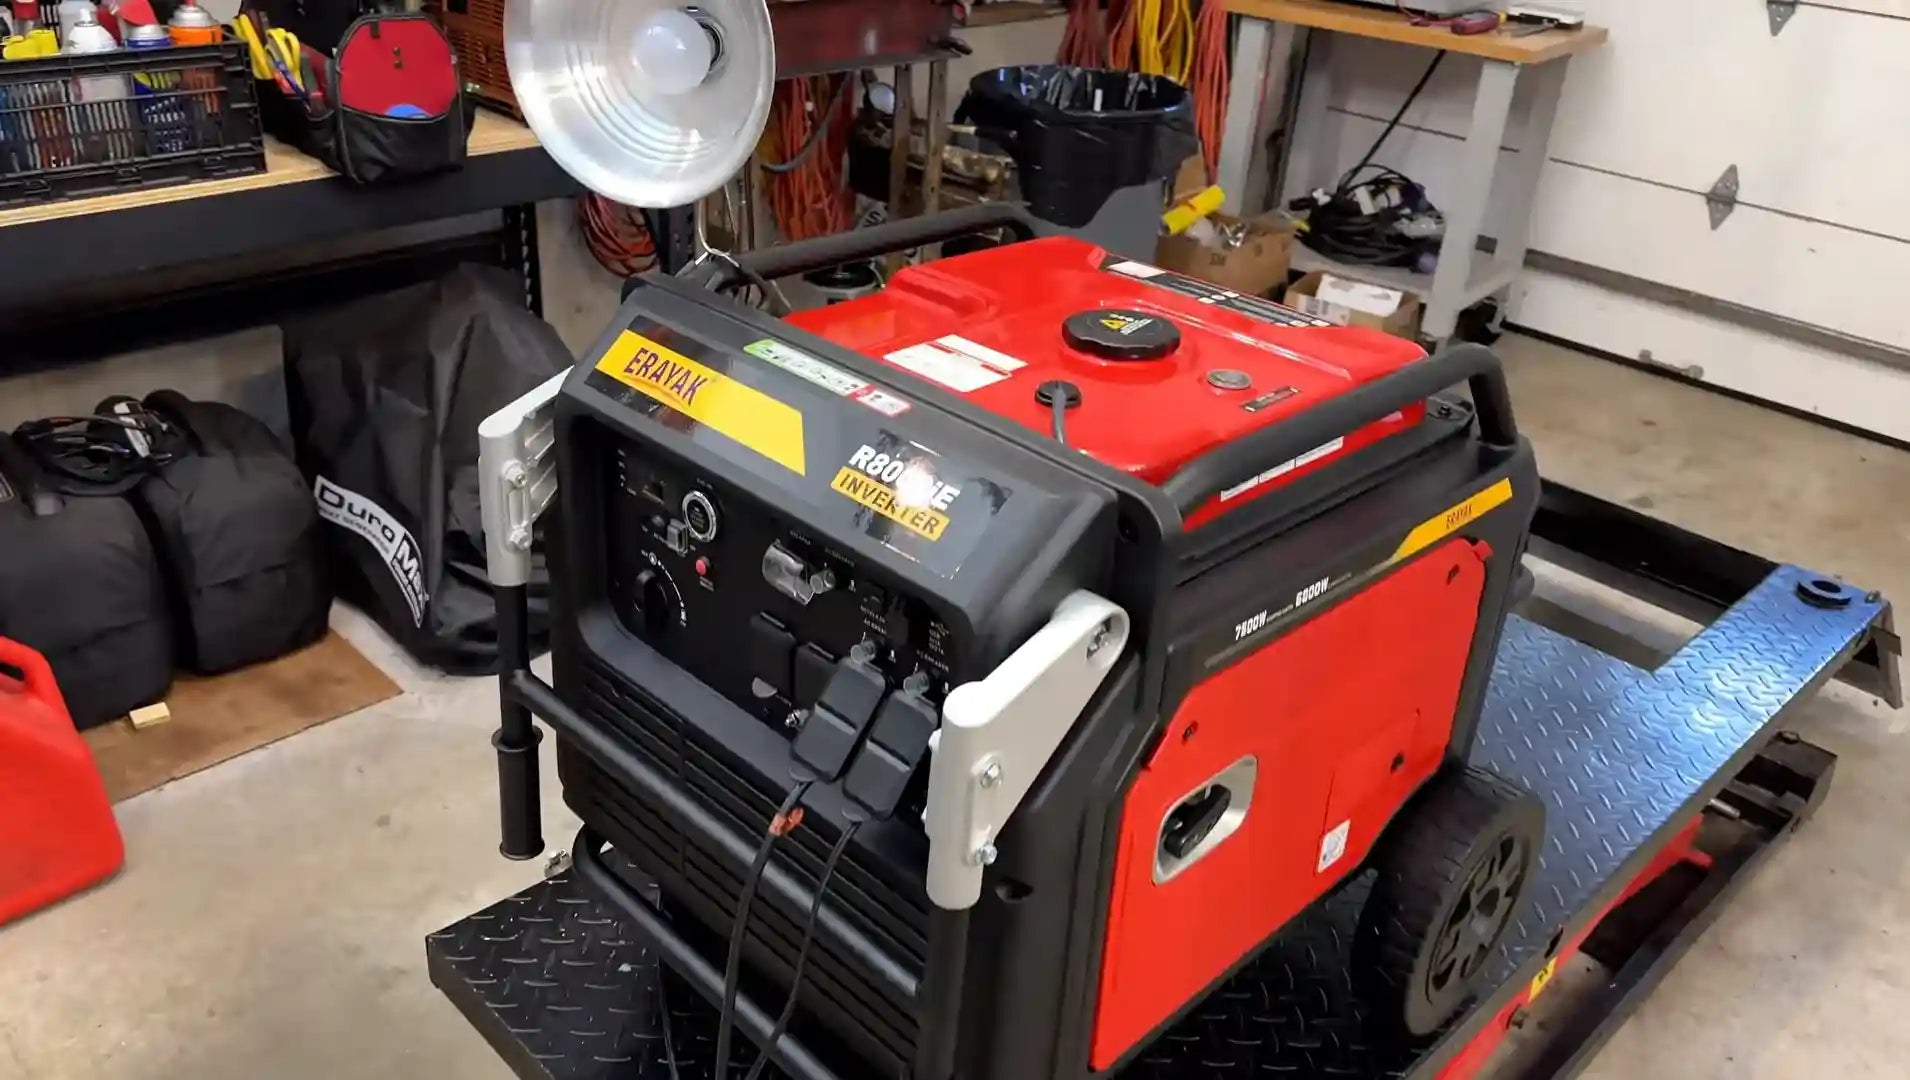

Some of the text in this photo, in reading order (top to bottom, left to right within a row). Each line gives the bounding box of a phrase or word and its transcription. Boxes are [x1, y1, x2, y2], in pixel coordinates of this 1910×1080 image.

[623, 347, 708, 407] ERAYAK
[848, 444, 961, 511] R80iE
[1295, 576, 1330, 608] 6000W
